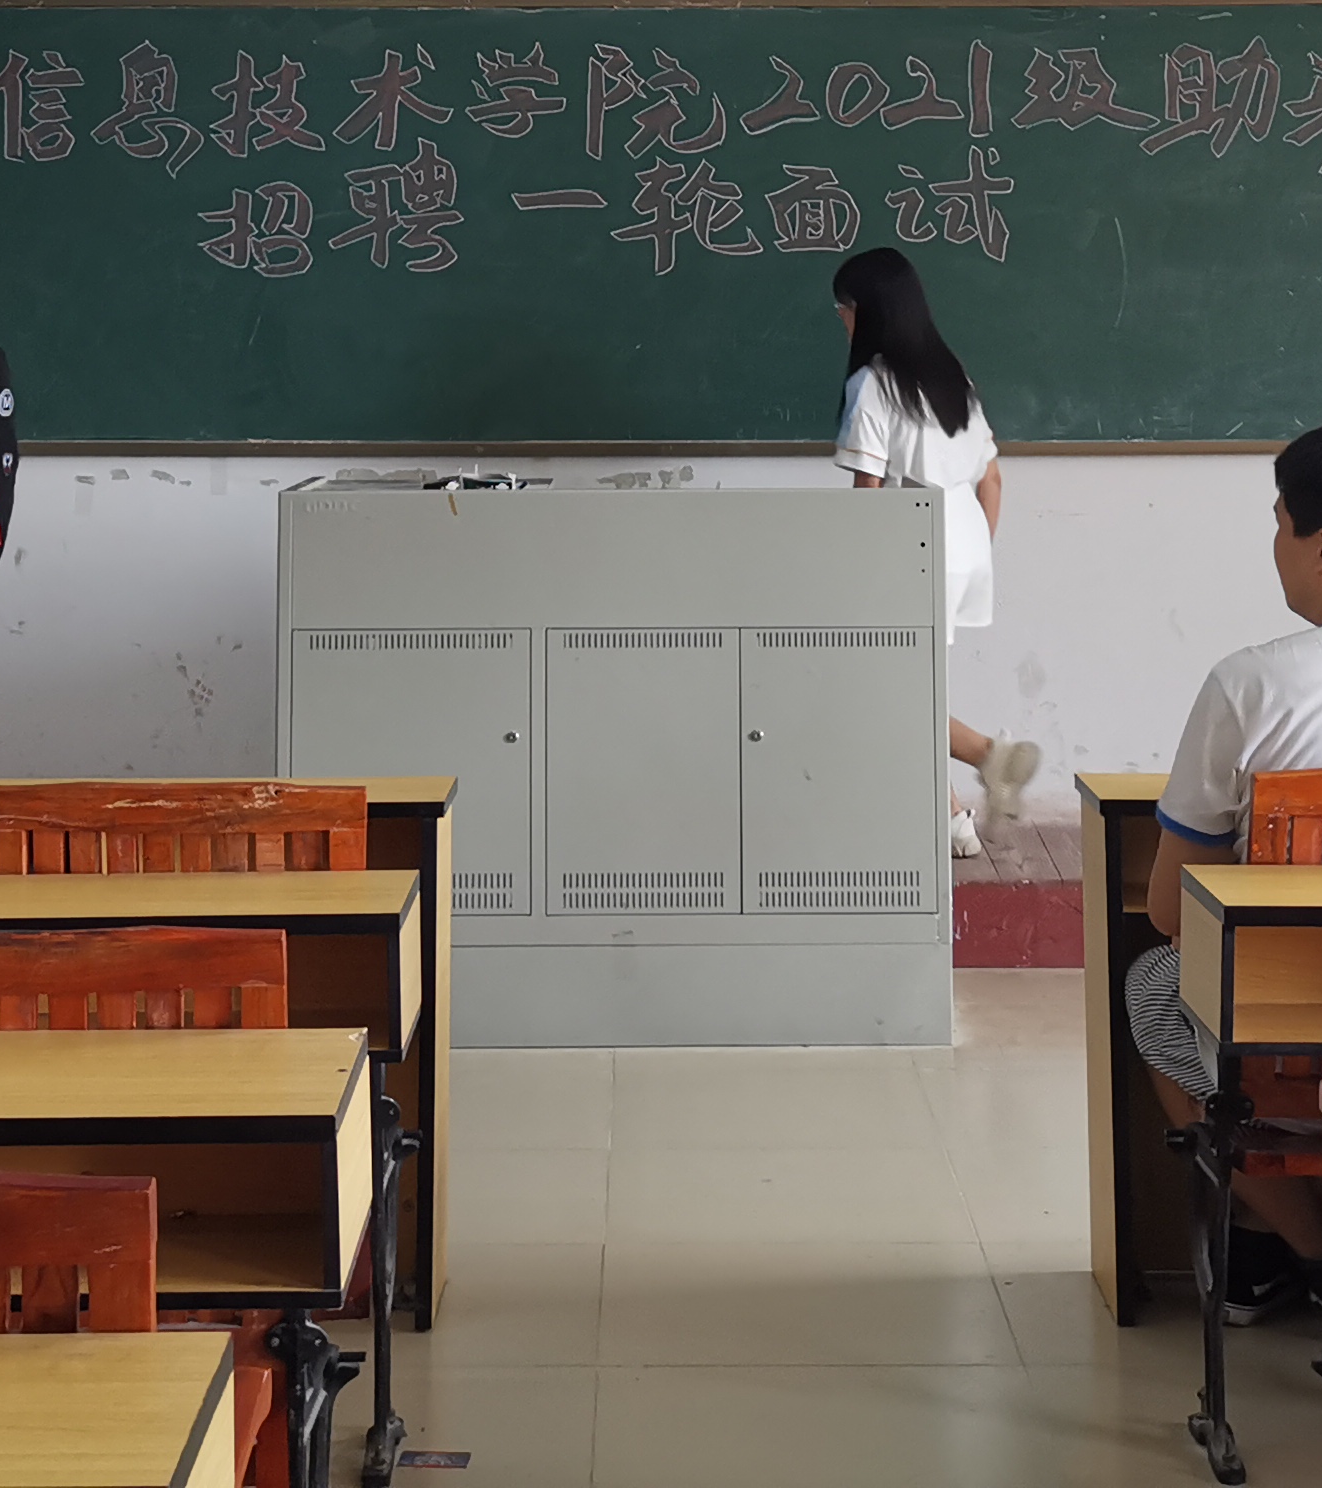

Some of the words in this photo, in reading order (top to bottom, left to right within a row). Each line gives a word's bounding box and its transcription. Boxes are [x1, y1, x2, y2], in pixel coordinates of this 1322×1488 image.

[197, 137, 1014, 278] 招聘一轮面试
